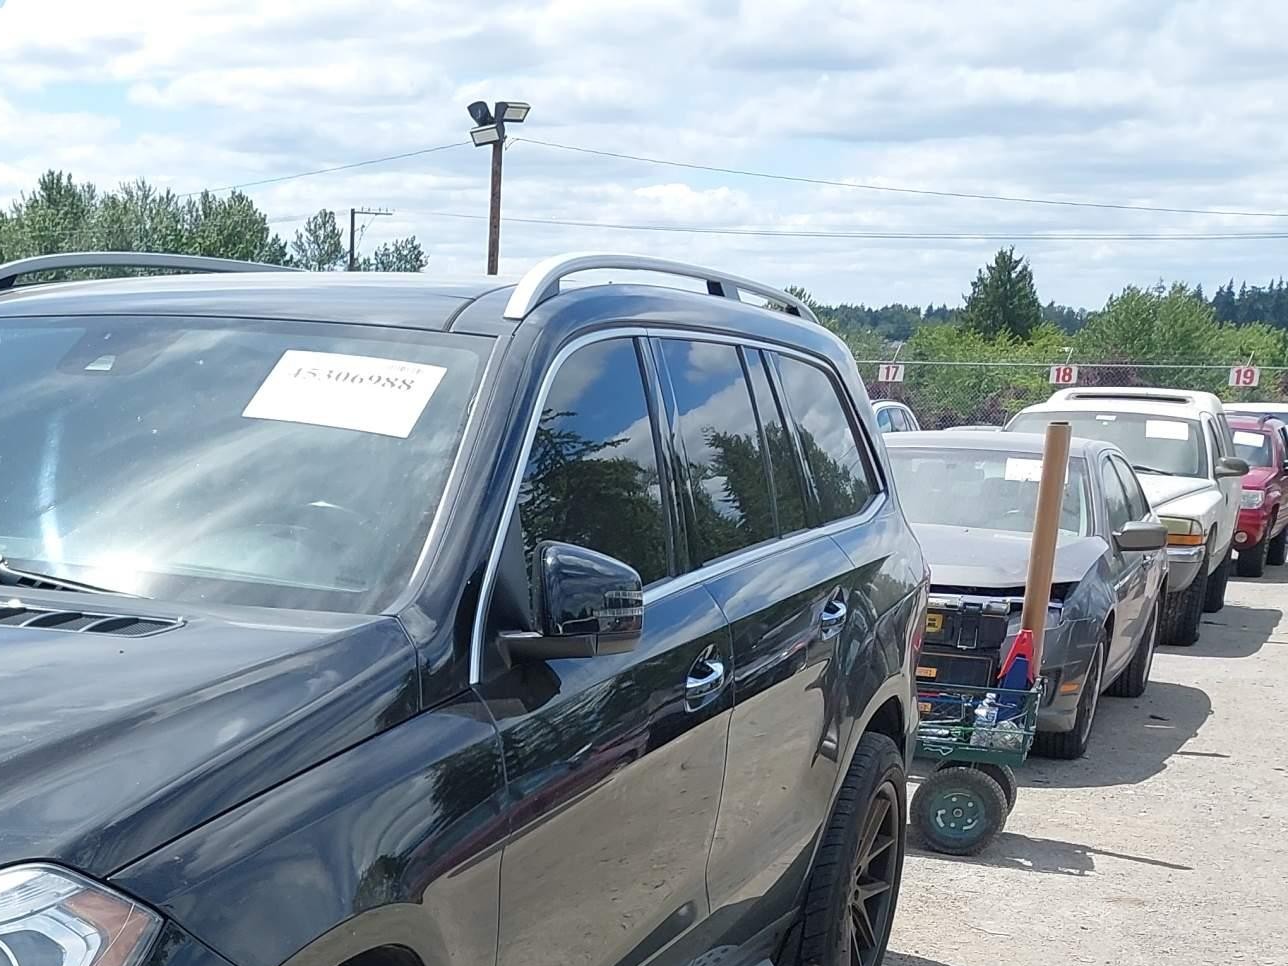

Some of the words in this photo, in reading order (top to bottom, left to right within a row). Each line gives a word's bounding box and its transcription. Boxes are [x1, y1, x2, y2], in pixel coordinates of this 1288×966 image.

[885, 365, 899, 380] 17
[1055, 367, 1073, 383] 18
[1235, 368, 1255, 385] 19
